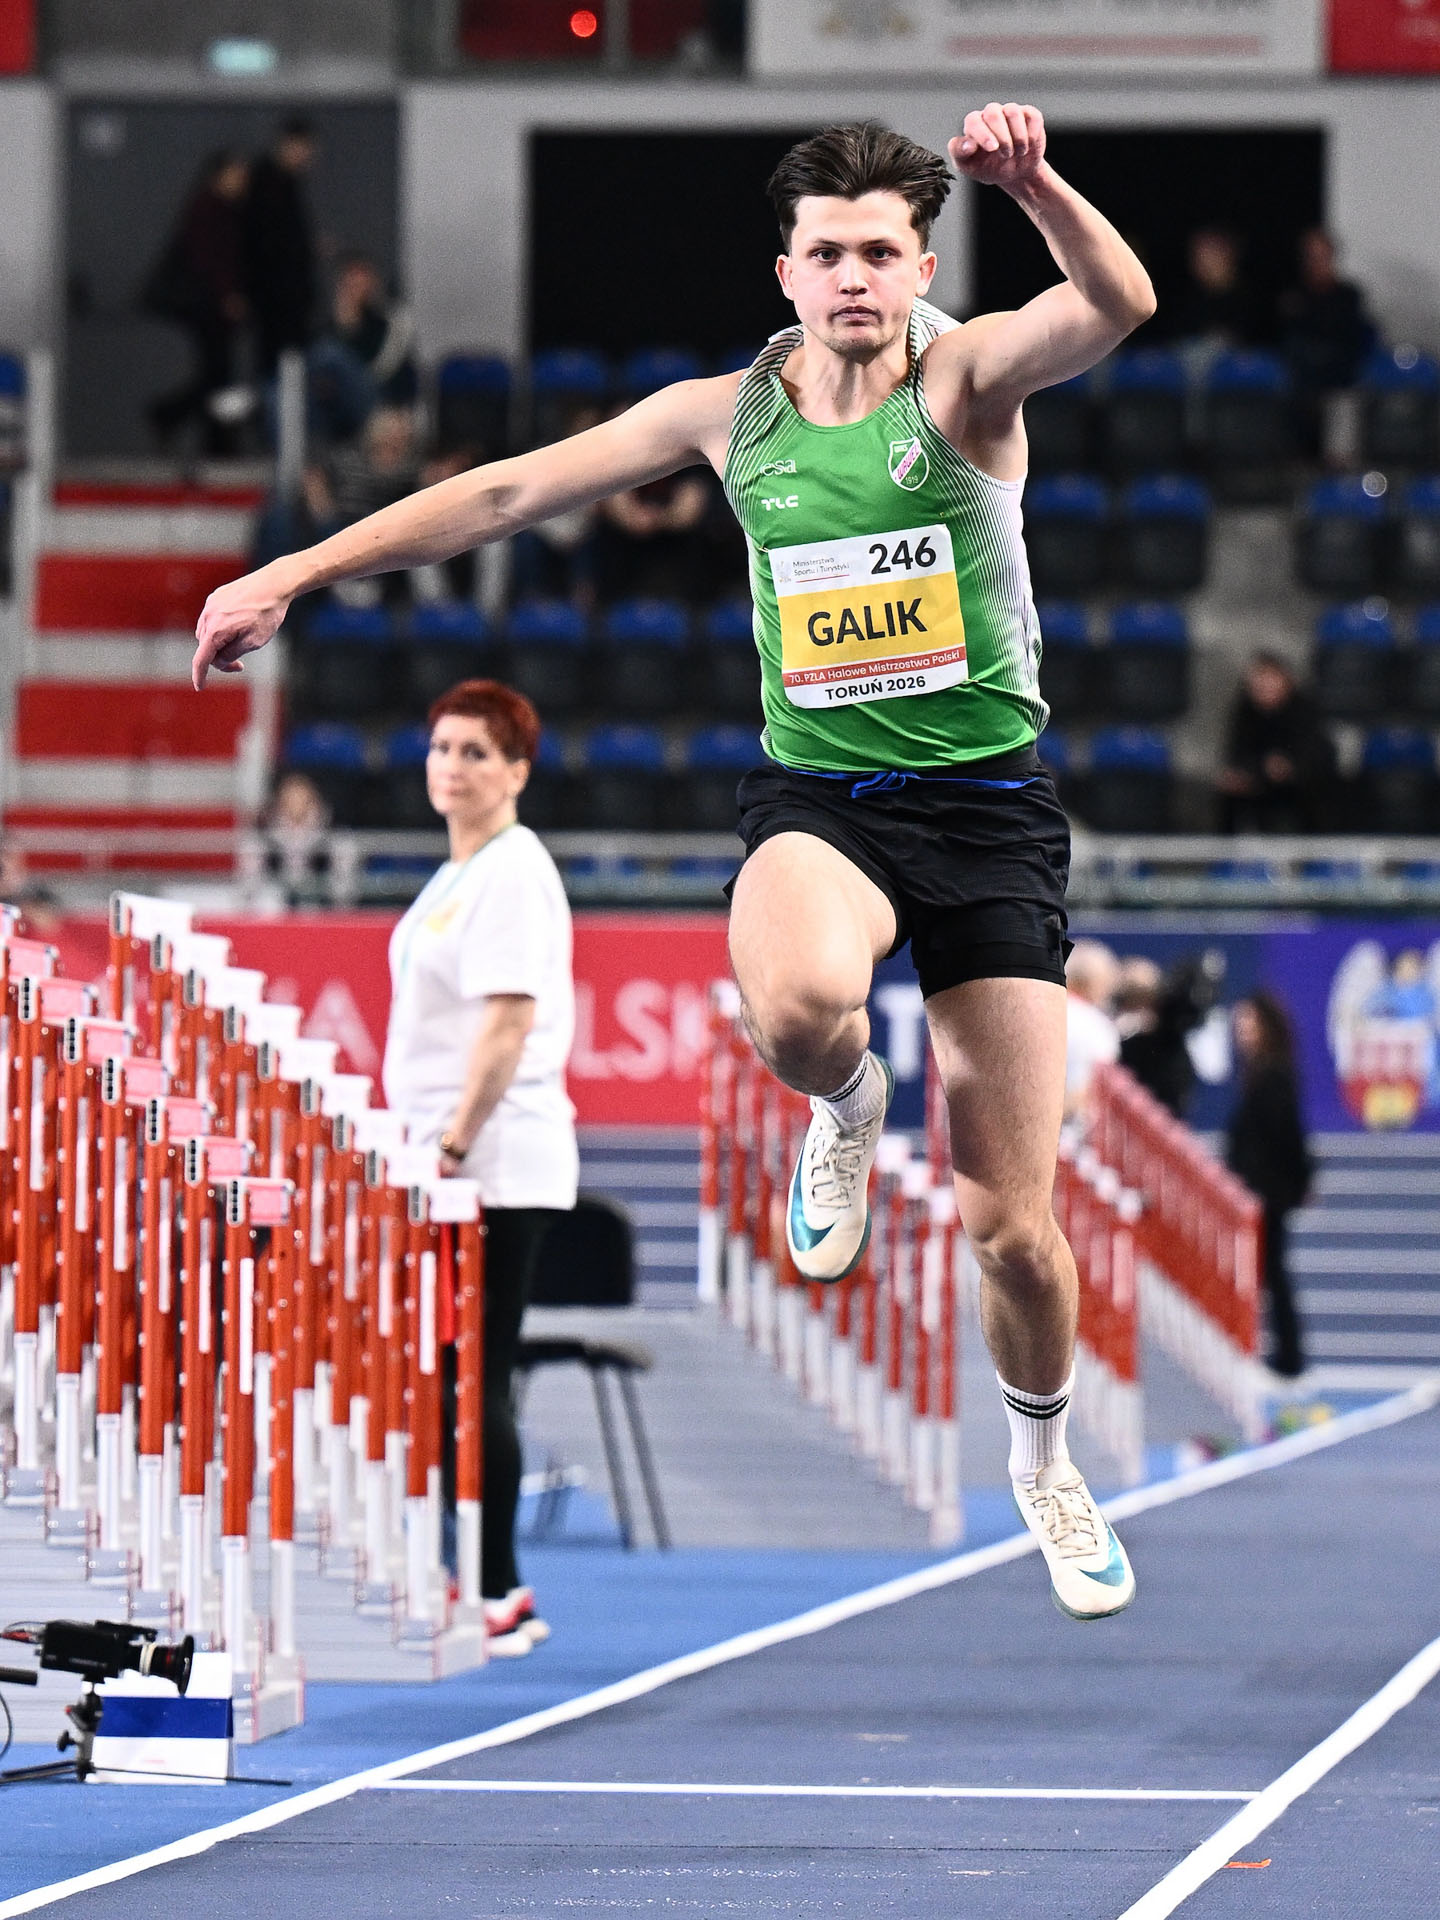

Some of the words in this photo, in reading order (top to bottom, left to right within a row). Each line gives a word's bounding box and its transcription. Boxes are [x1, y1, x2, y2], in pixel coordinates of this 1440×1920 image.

[760, 494, 799, 512] TLC
[820, 562, 850, 573] Turystyki
[869, 535, 936, 574] 246
[808, 598, 928, 646] GALIK
[789, 674, 803, 684] 70.
[803, 670, 825, 683] PZLA
[827, 666, 866, 680] Halowe
[868, 657, 930, 674] Mistrzostwa
[931, 649, 960, 665] Polski
[825, 678, 883, 700] TORUŃ
[886, 675, 926, 692] 2026
